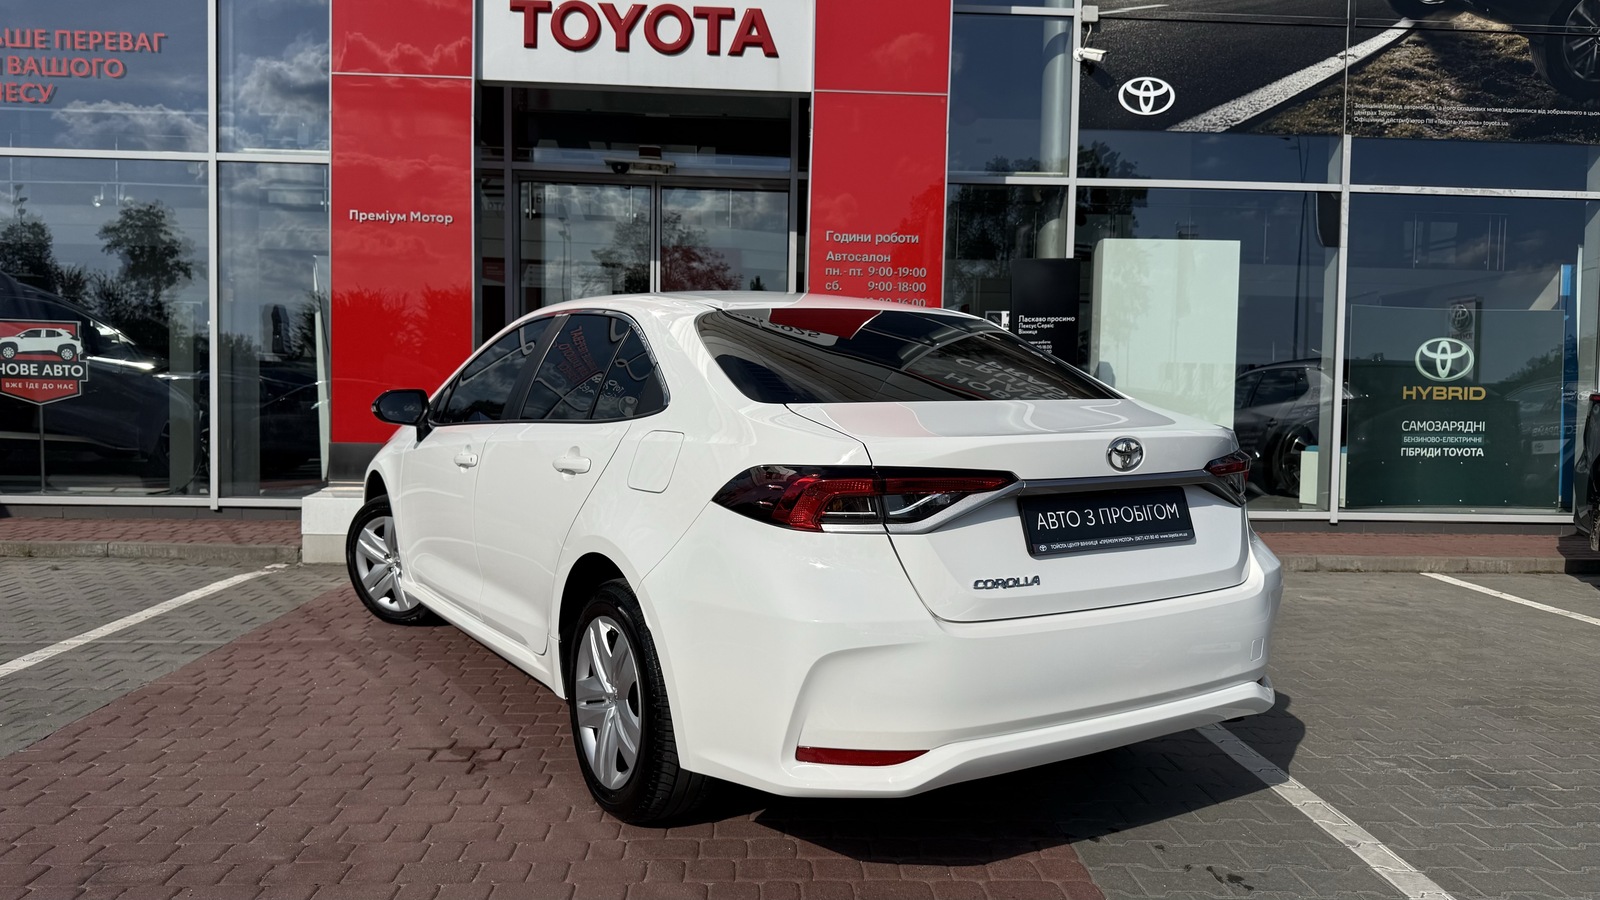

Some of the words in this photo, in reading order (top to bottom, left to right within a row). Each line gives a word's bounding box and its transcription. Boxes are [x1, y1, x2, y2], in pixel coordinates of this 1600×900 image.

[510, 0, 779, 58] TOYOTA
[54, 29, 167, 53] ПЕРЕВАГ
[7, 55, 125, 78] ВАШОГО
[1546, 108, 1582, 116] зображеного
[1483, 119, 1509, 127] toyota.ua
[348, 209, 407, 225] Преміум
[409, 211, 454, 226] Мотор
[825, 230, 872, 243] Години
[875, 231, 919, 245] роботи
[825, 250, 892, 263] Автосалон
[825, 280, 843, 291] сб.
[1047, 316, 1076, 324] просимо
[42, 363, 84, 377] АВТО
[5, 381, 23, 389] ВЖЕ
[41, 382, 55, 390] ДО
[1402, 385, 1487, 400] HYBRID
[1401, 420, 1486, 433] САМОЗАРЯДНІ
[1403, 436, 1483, 444] БЕНЗИНОВО-ЕЛЕКТРИЧНІ
[1400, 447, 1442, 459] ГІБРИДИ
[1443, 447, 1484, 457] TOYOTA
[1036, 509, 1081, 531] АВТО
[1098, 502, 1180, 525] ПРОБІГОМ
[973, 574, 1041, 590] COROLLA
